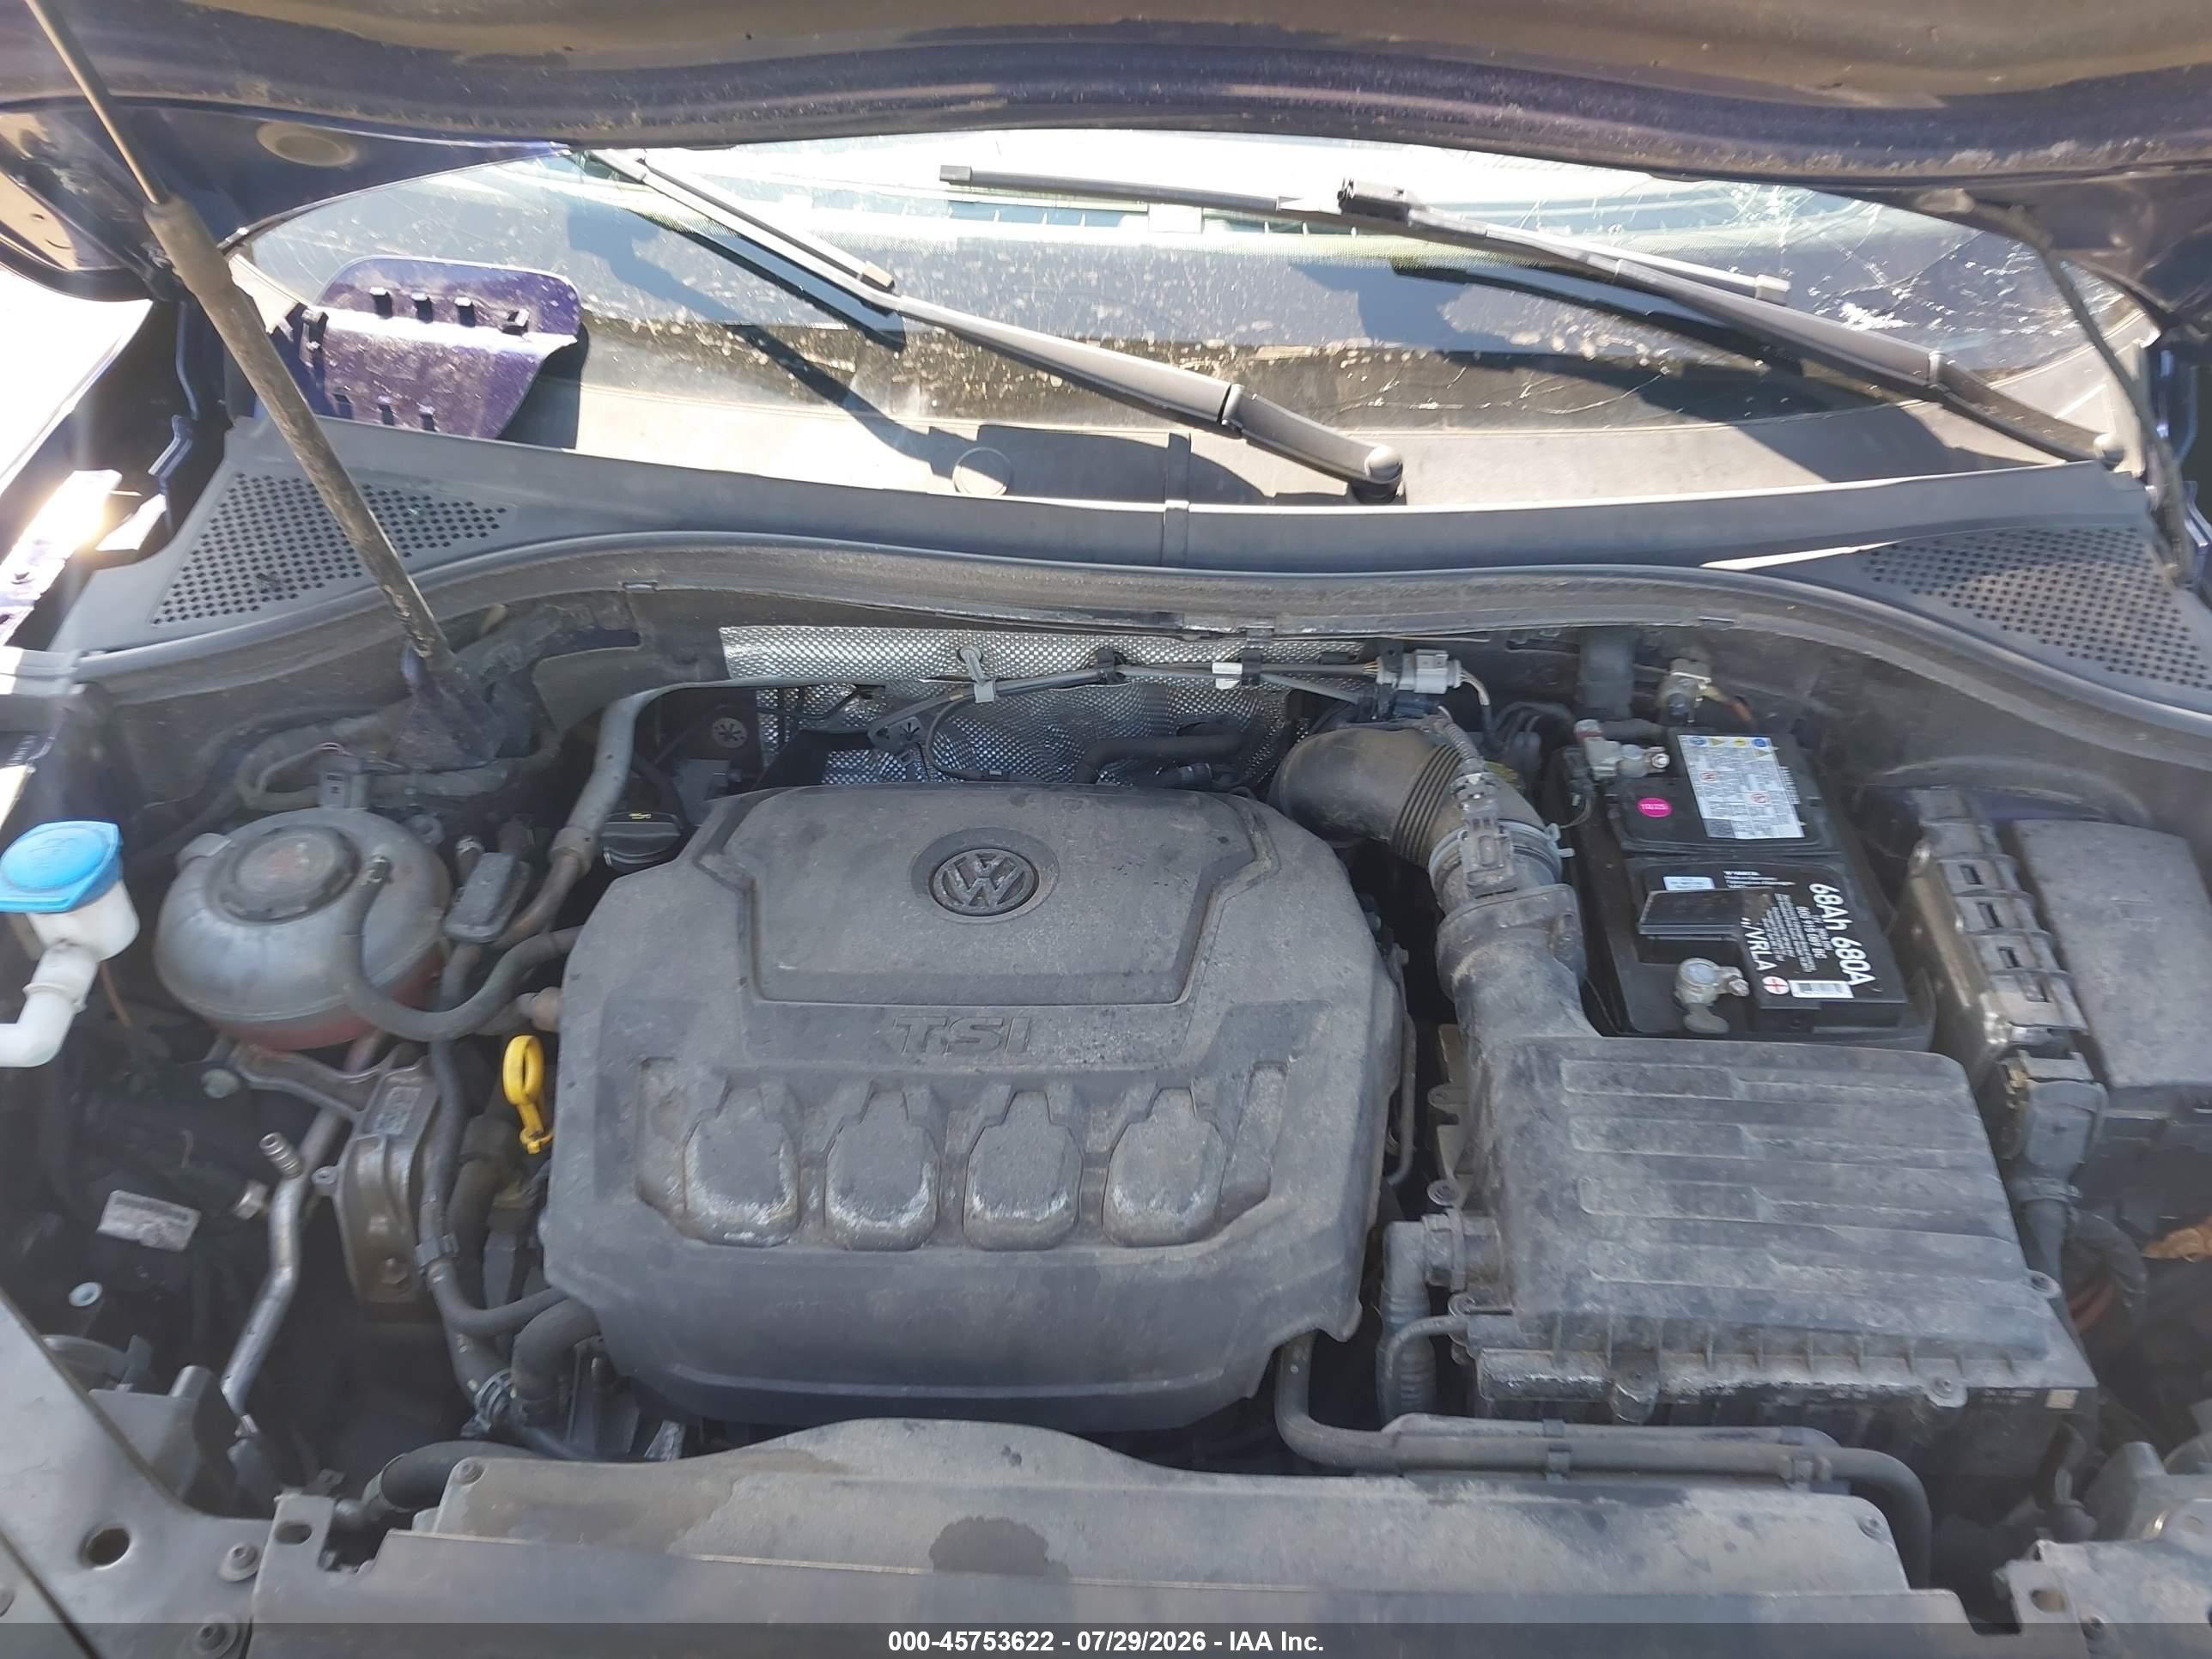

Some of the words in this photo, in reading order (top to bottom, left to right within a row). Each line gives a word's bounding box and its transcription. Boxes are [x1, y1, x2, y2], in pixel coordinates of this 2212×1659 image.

[938, 850, 1035, 910] VW
[1809, 884, 1853, 930] 68Ah
[1831, 937, 1876, 986] 680A
[893, 1017, 1031, 1054] TSI
